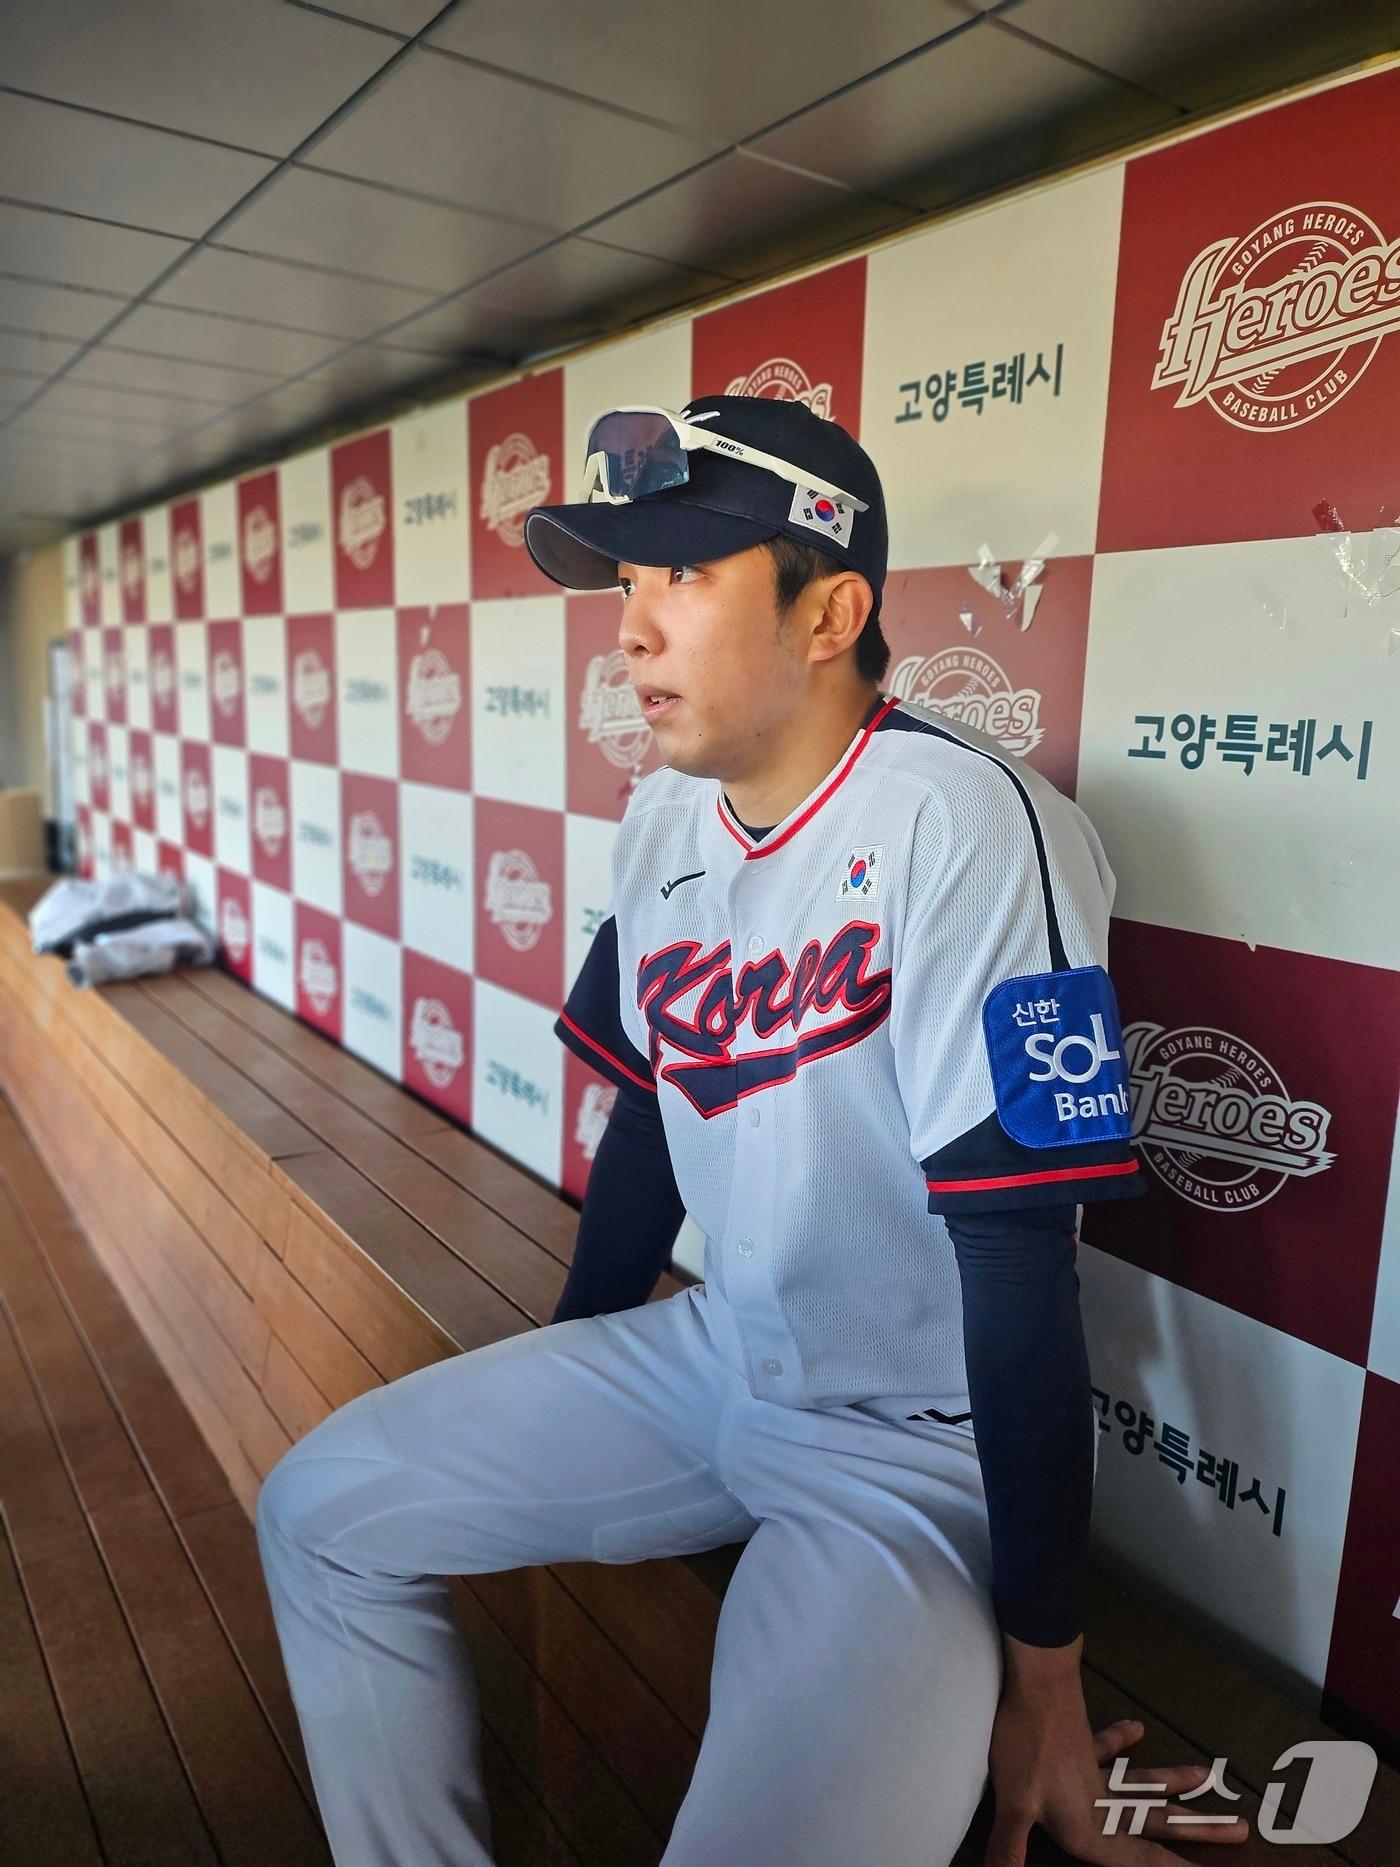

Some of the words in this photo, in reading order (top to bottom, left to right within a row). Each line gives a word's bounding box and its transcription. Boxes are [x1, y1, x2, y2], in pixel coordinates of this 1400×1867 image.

[1231, 218, 1295, 276] GOYANG
[1302, 213, 1365, 246] HEROES
[895, 343, 1064, 423] 고양특례시
[1222, 391, 1299, 423] BASEBALL
[1305, 369, 1349, 411] CLUB
[715, 438, 745, 457] 100%
[920, 655, 961, 687] GOYANG
[962, 655, 1001, 689] HEROES
[1127, 713, 1373, 780] 고양특례시
[636, 919, 893, 1072] Korea
[1011, 998, 1061, 1027] 신한
[1159, 1035, 1213, 1061] GOYANG
[1218, 1040, 1272, 1090] HEROES
[1153, 1151, 1219, 1203] BASEBALL
[1224, 1182, 1261, 1204] CLUB
